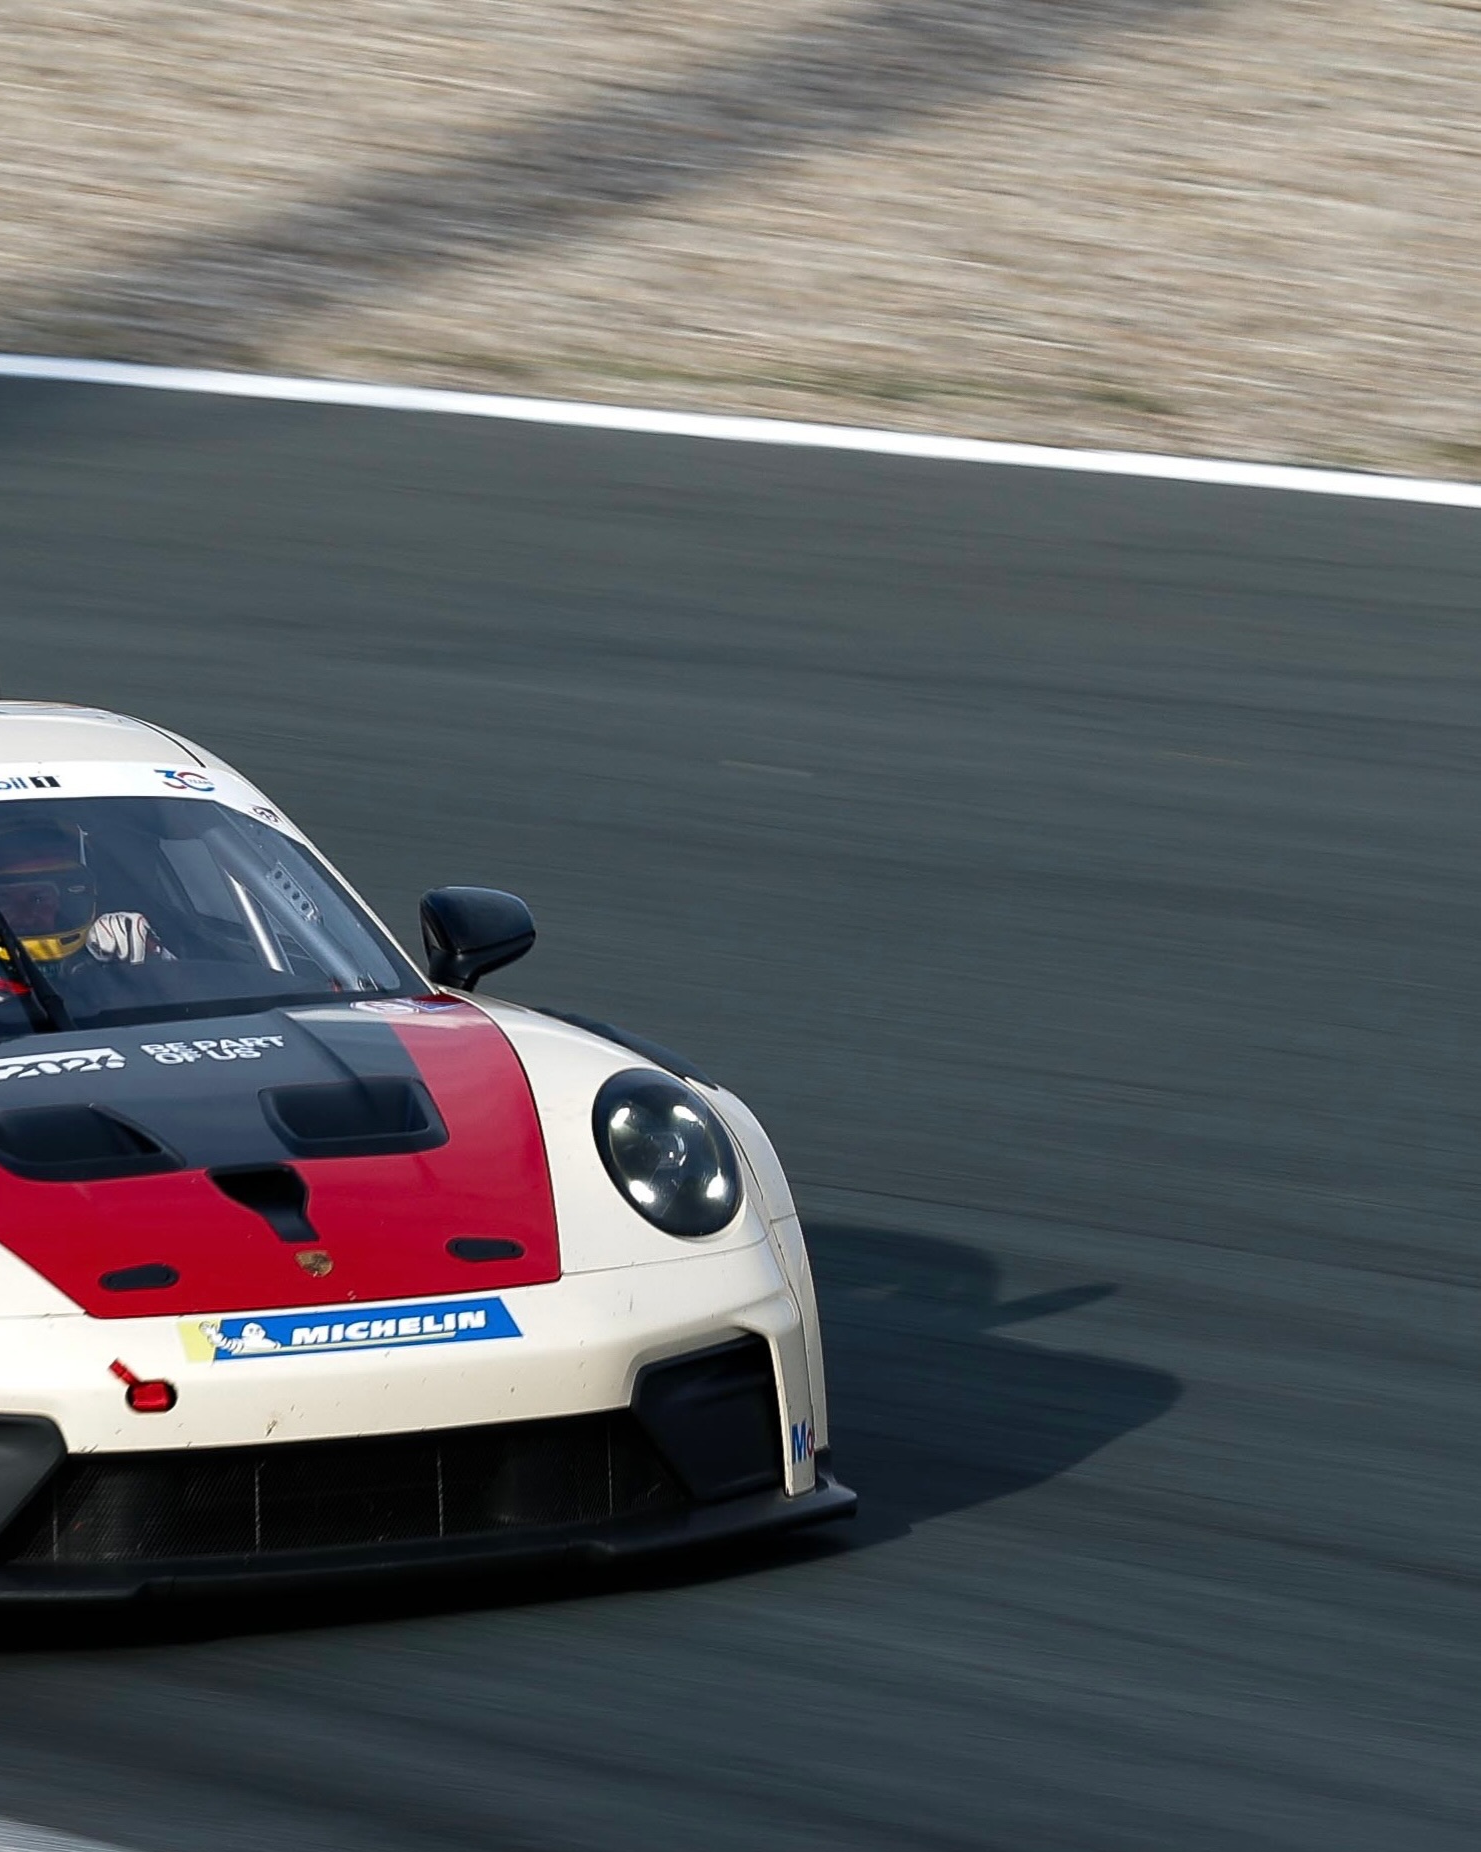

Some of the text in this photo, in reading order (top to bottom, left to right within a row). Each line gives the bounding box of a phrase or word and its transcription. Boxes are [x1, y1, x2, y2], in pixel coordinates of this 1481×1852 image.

[32, 776, 55, 789] 1
[140, 1035, 285, 1056] BE PART
[155, 1047, 261, 1064] OF US
[291, 1310, 486, 1345] MICHELIN
